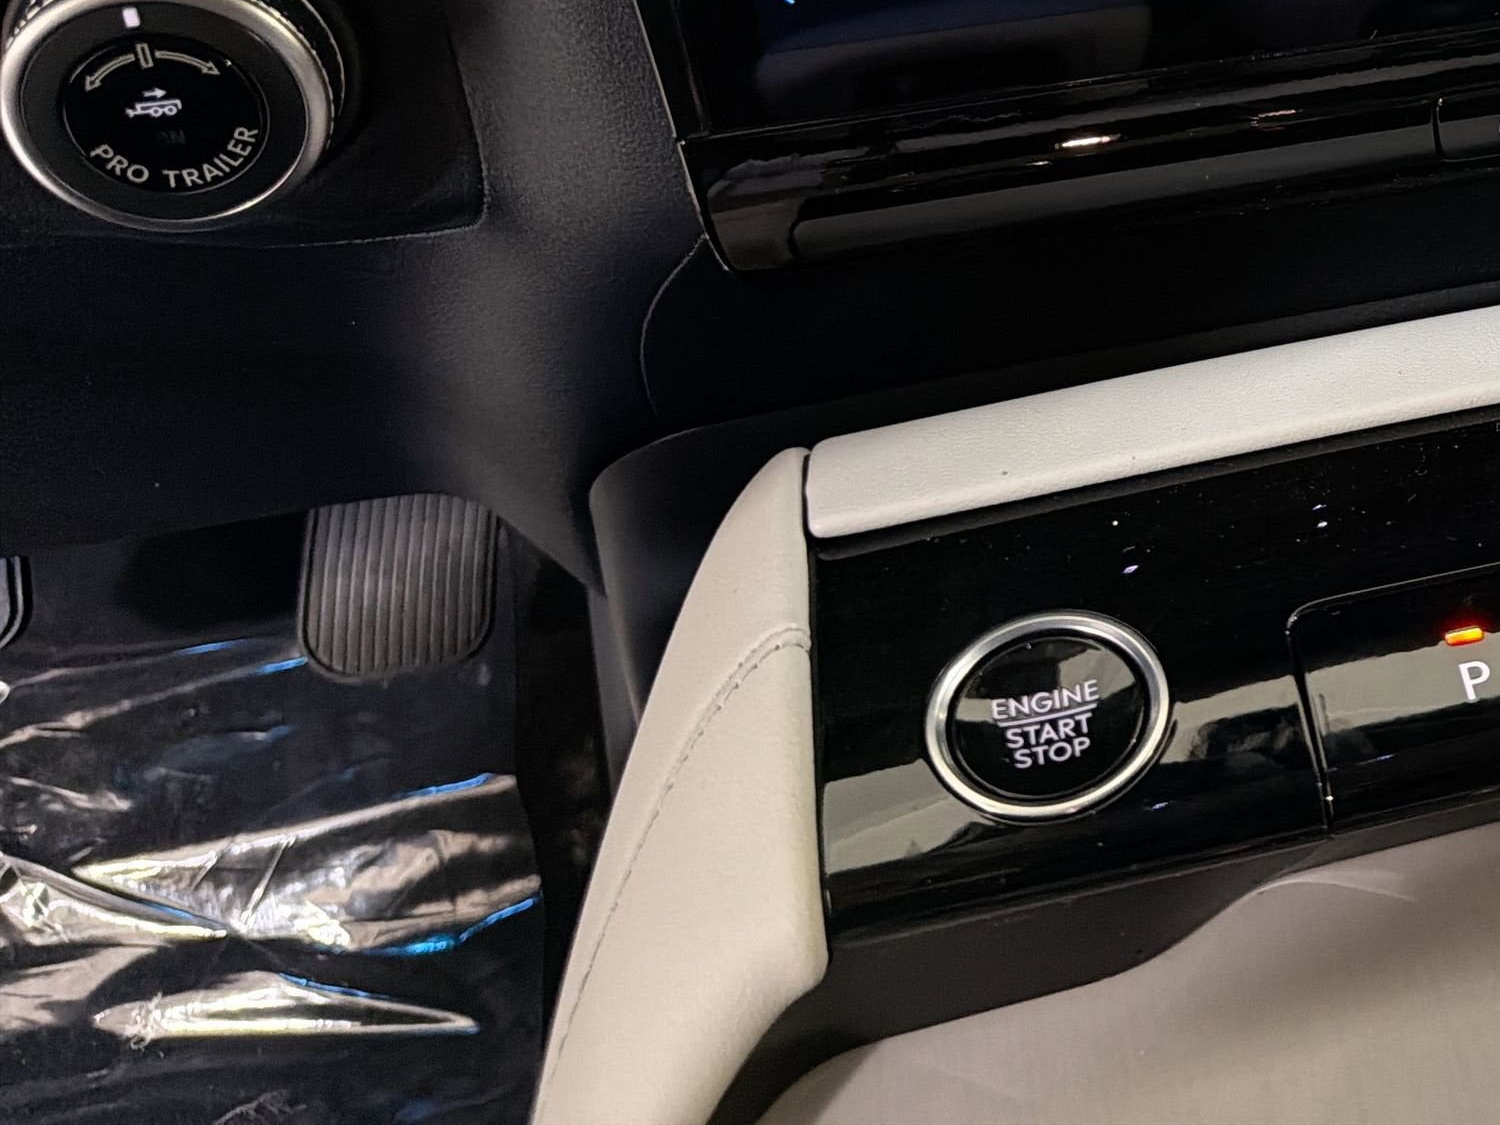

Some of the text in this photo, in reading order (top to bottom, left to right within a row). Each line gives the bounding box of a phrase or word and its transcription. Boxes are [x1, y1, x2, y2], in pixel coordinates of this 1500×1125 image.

[89, 126, 258, 188] PRO TRAILER
[991, 679, 1100, 720] ENGINE
[1458, 660, 1492, 701] P
[1005, 713, 1093, 749] START
[1014, 736, 1091, 769] STOP
